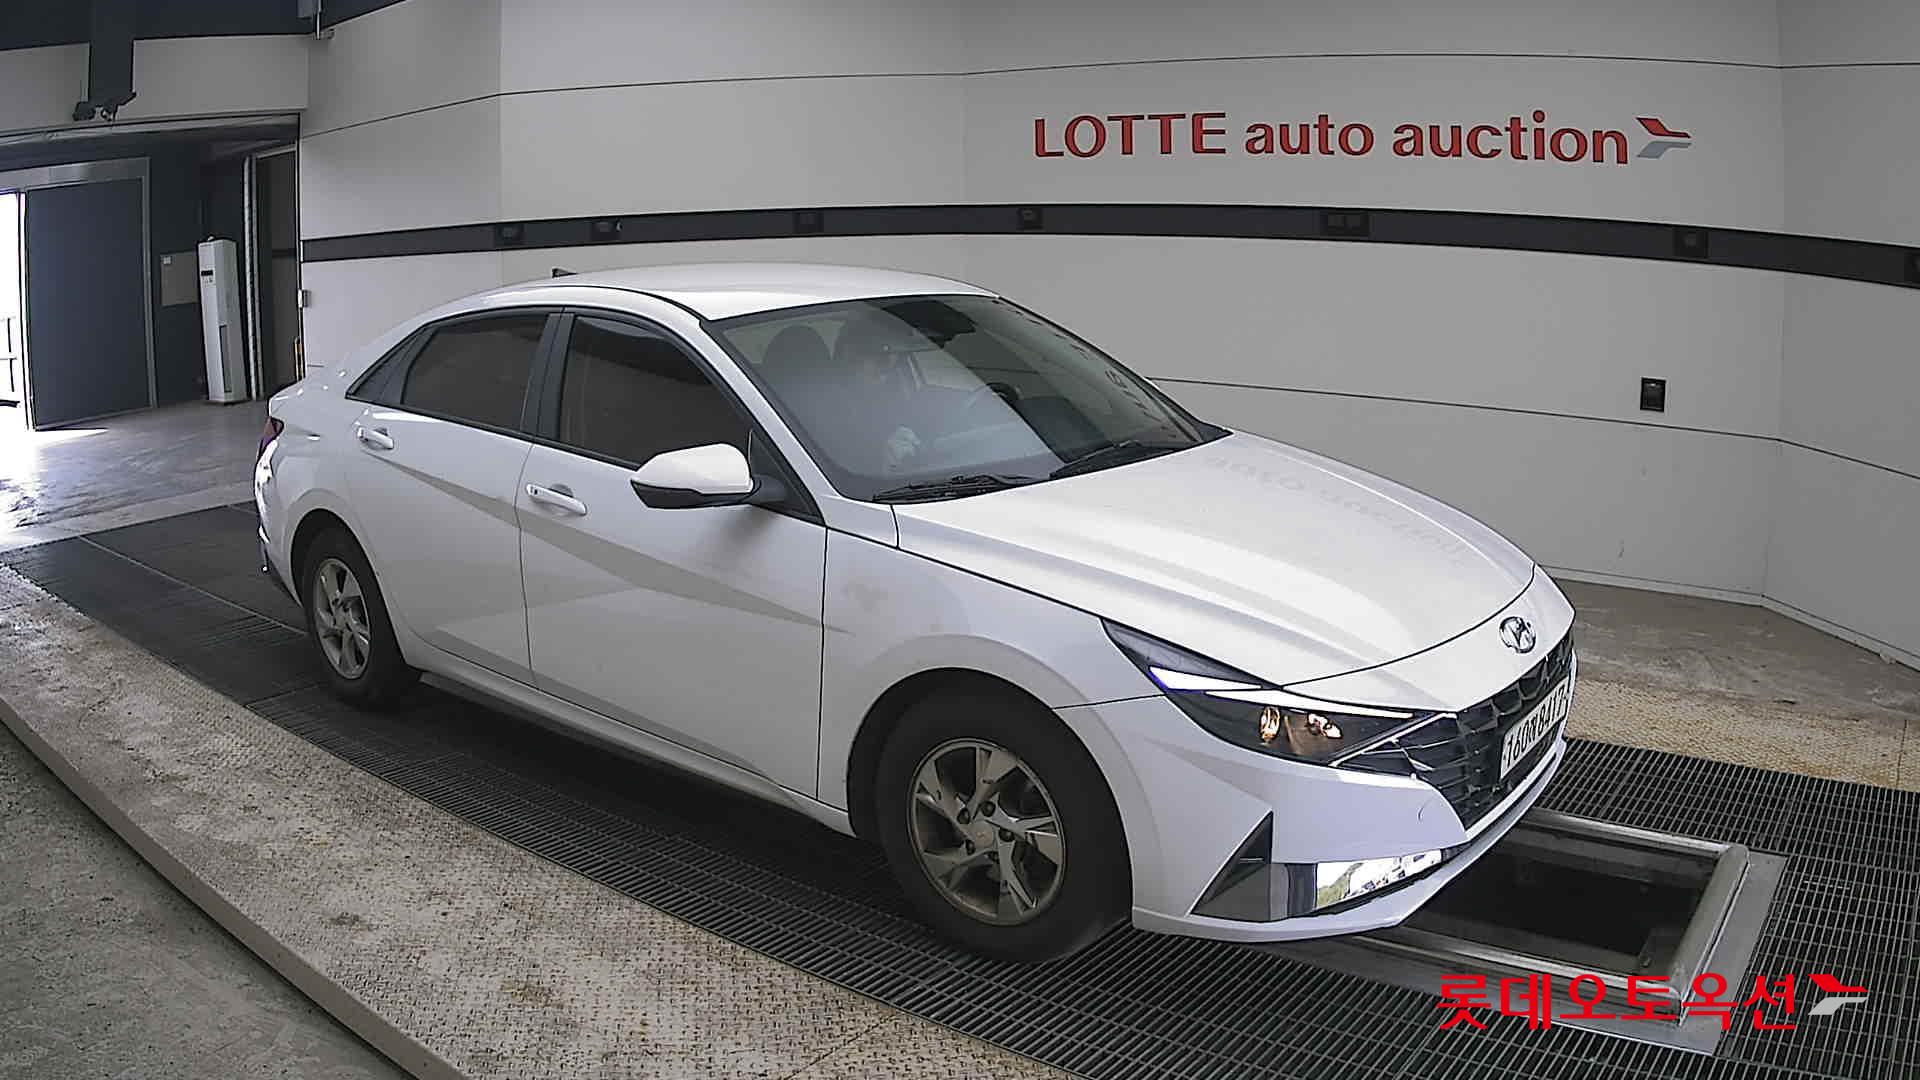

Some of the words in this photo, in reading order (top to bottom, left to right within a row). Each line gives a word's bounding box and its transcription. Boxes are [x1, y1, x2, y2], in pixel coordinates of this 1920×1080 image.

[1034, 112, 1227, 158] LOTTE
[1245, 114, 1375, 156] auto
[1392, 110, 1629, 165] auction
